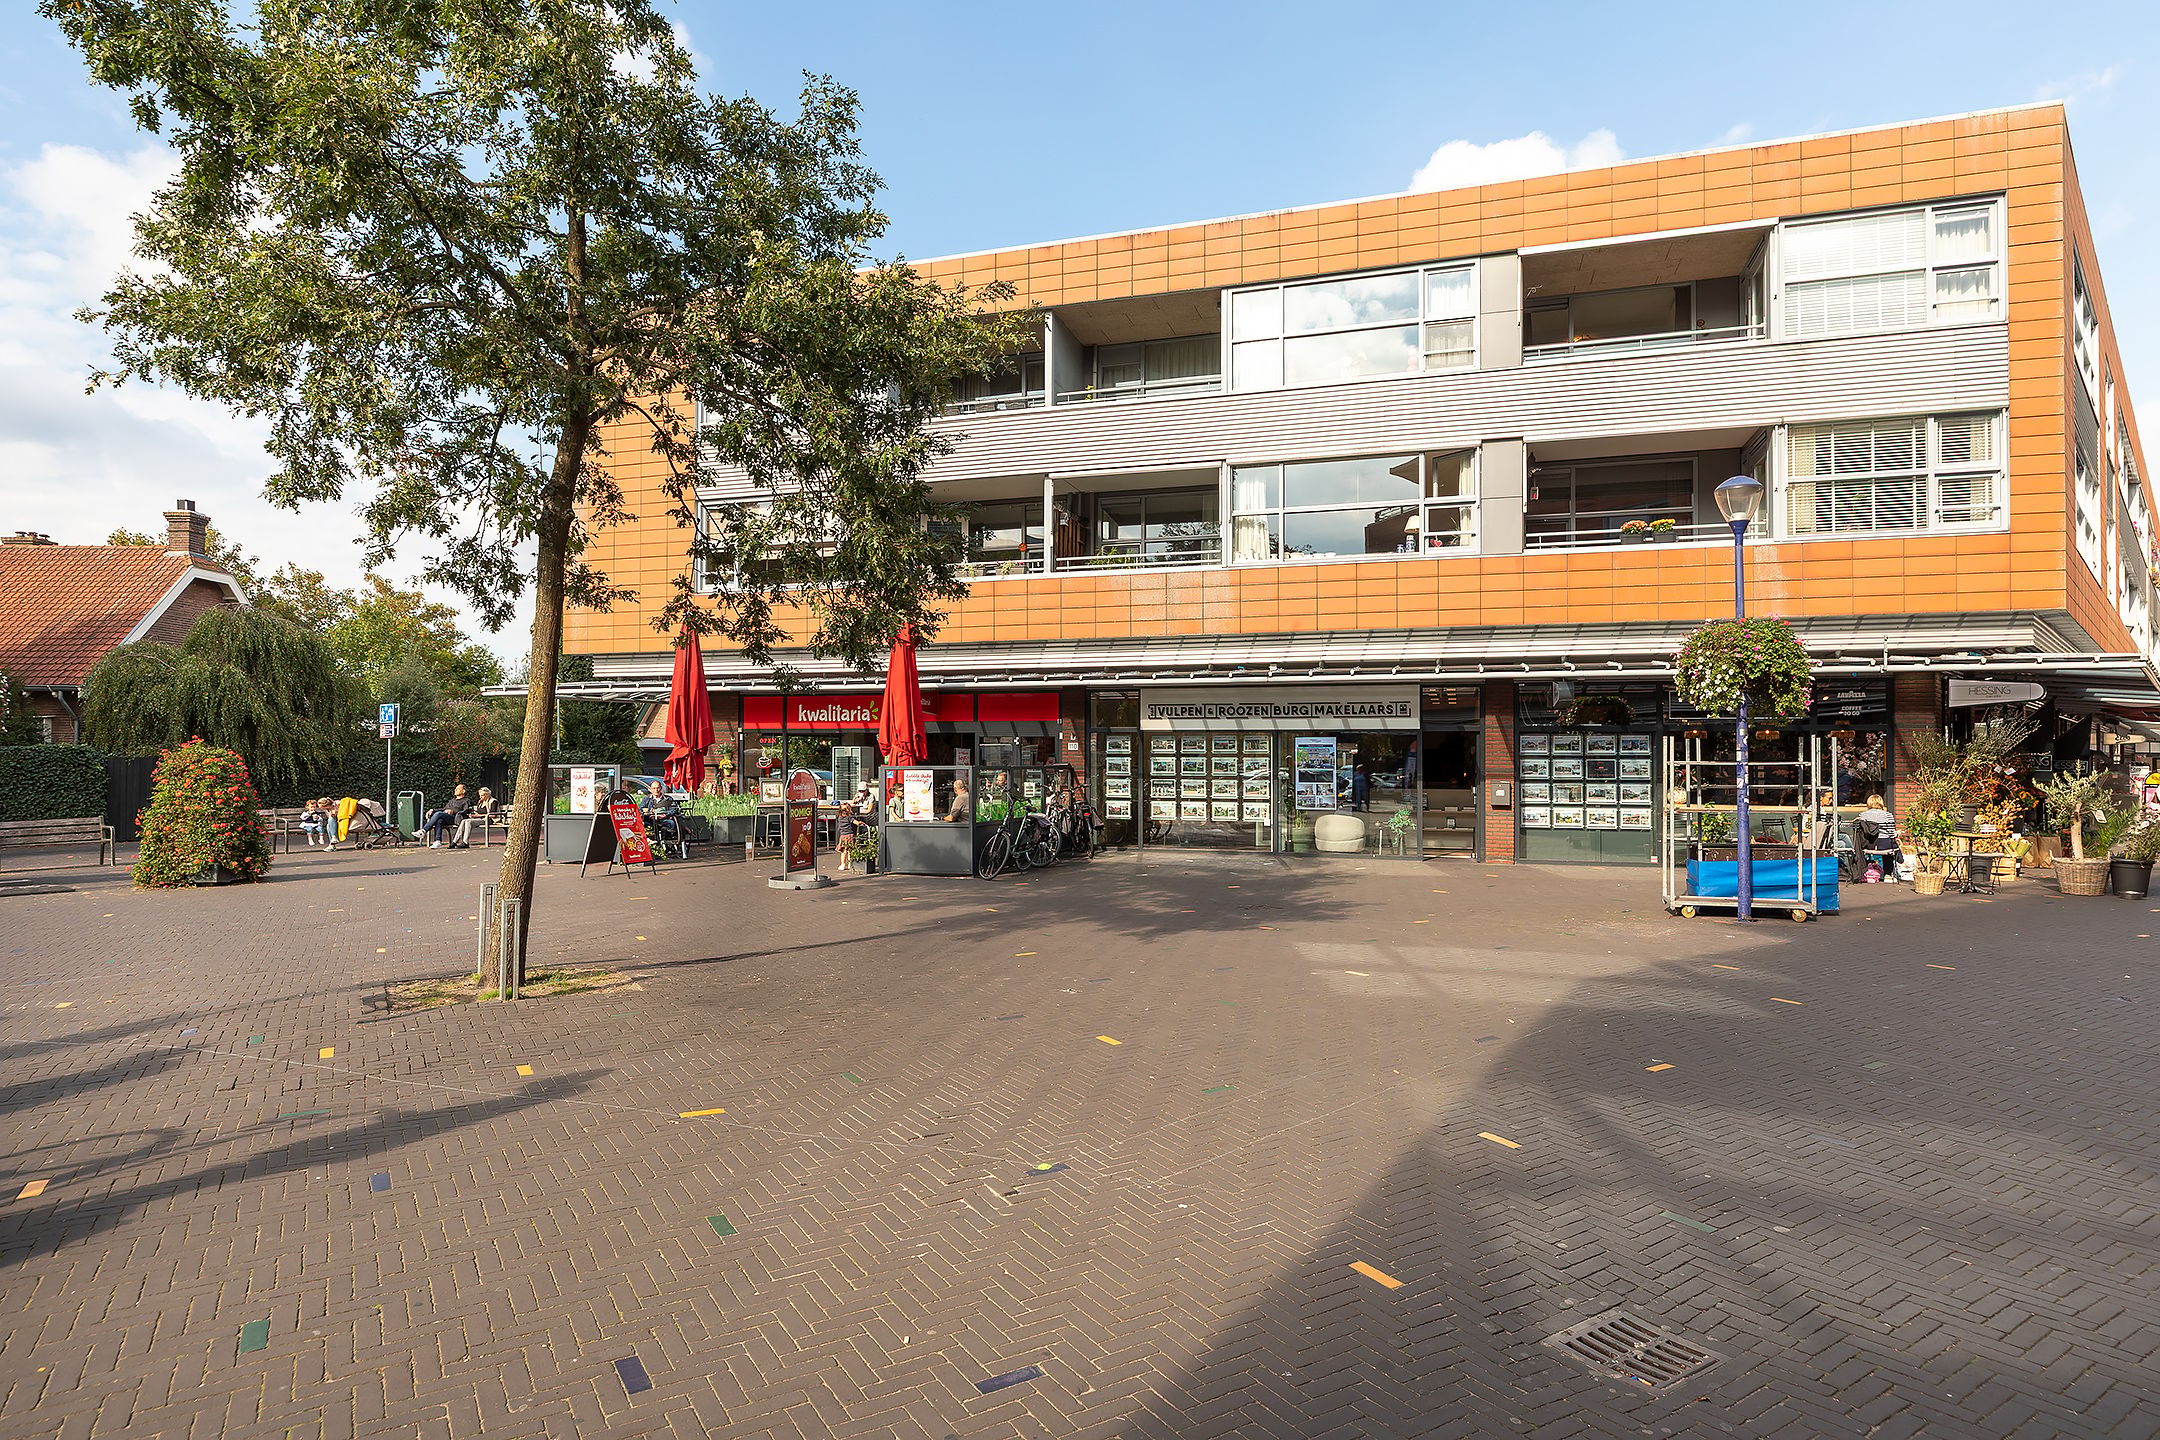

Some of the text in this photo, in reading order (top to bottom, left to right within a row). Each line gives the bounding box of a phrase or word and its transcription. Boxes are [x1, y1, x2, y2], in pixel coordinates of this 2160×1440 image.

[1837, 690, 1866, 698] LAVAZZA
[1968, 686, 2011, 695] HESSING
[798, 704, 871, 721] kwalitaria
[1157, 706, 1203, 716] VULPEN
[1207, 707, 1214, 715] &
[1314, 704, 1394, 715] MAKELAARS
[789, 806, 813, 818] ROMIG!
